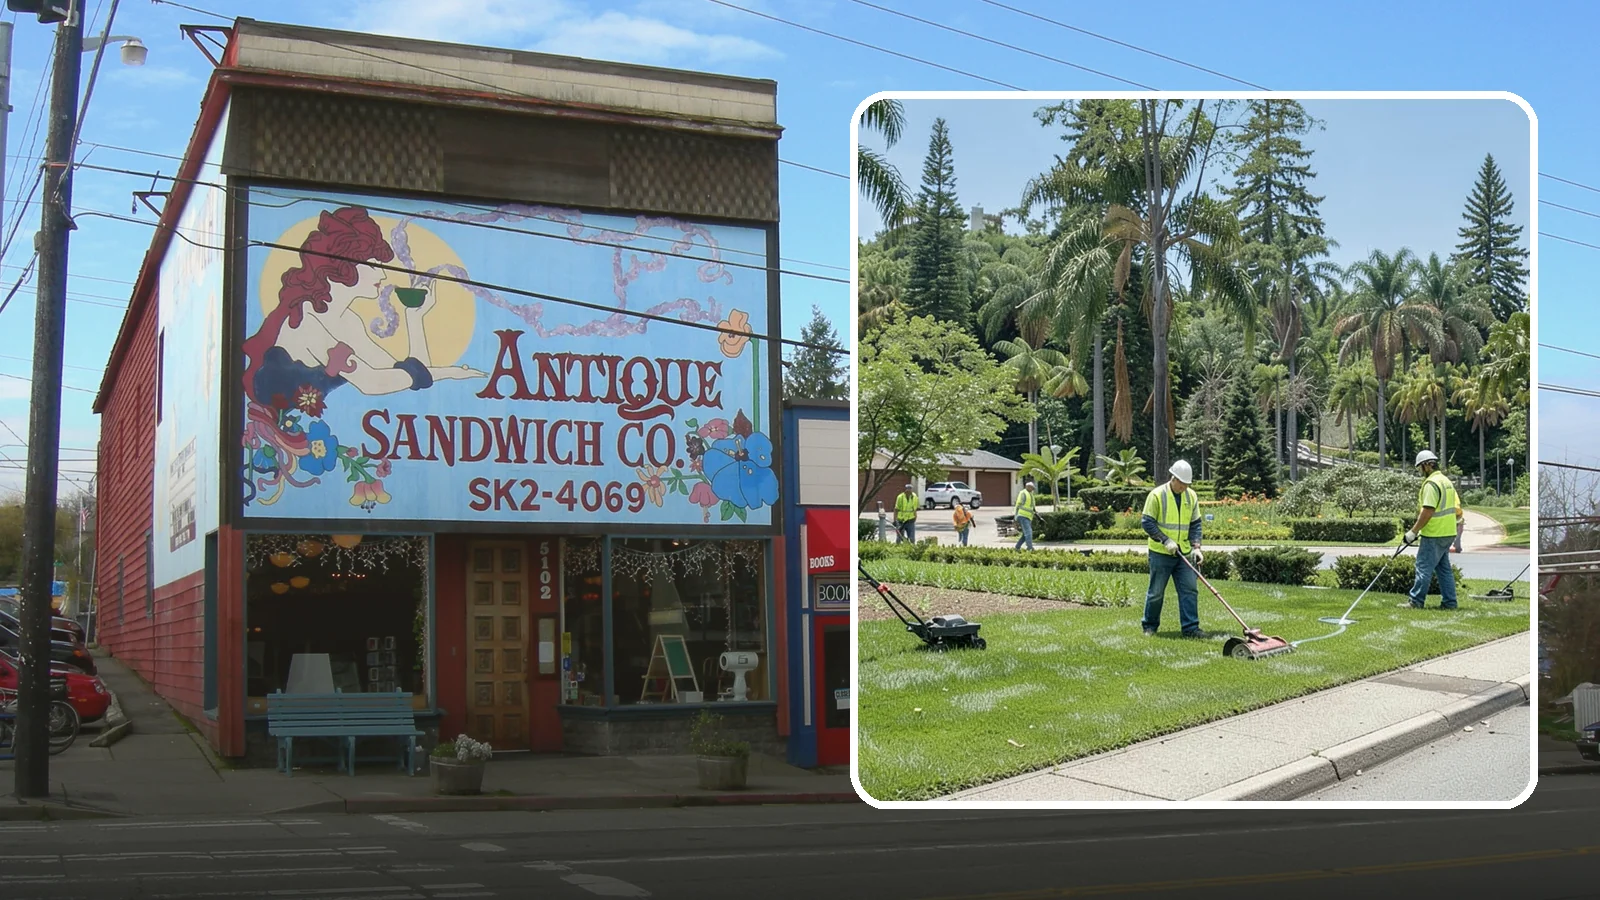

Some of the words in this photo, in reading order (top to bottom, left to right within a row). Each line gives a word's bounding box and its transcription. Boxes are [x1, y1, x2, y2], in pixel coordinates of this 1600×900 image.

[477, 329, 723, 420] ANTIQUE
[361, 409, 604, 467] SANDWICH
[617, 421, 685, 469] CO.
[469, 477, 646, 514] SK2-4069
[540, 542, 551, 599] 5102
[809, 555, 834, 568] BOOKS
